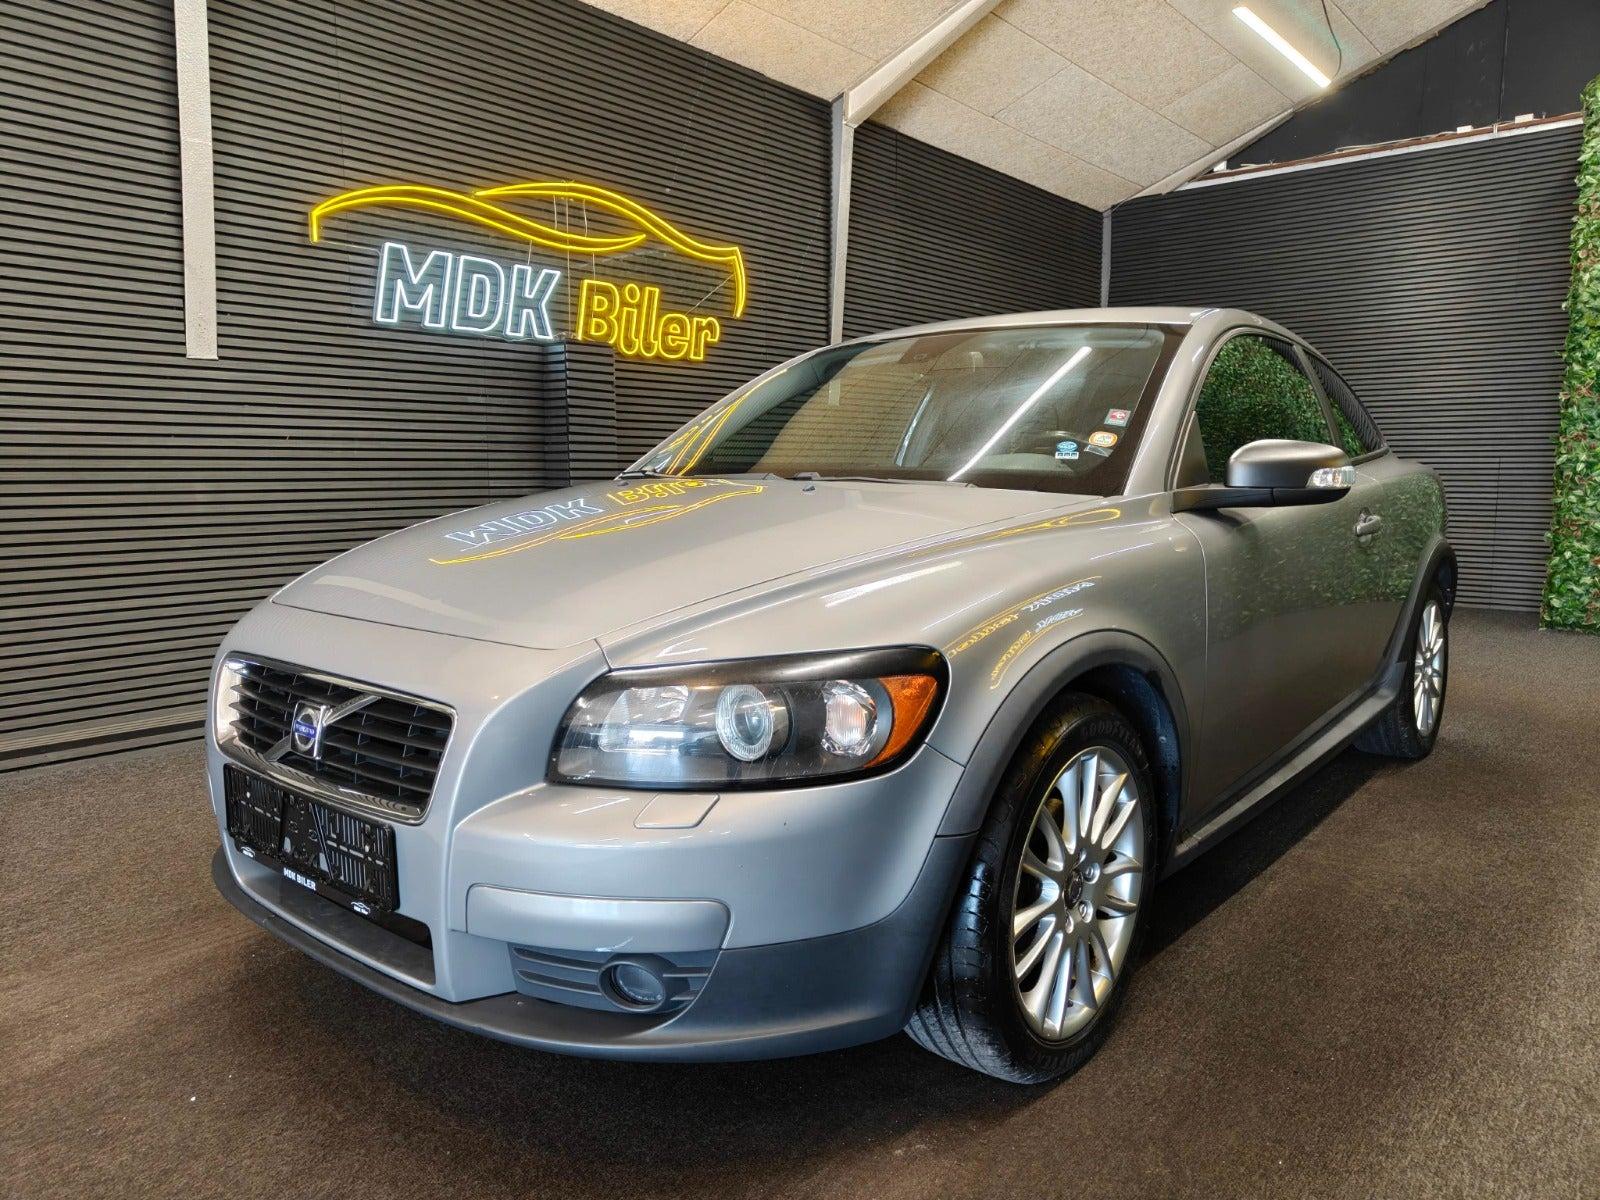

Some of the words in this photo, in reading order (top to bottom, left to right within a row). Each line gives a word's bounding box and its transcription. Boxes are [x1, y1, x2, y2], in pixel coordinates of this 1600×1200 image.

[373, 241, 561, 340] MDK
[576, 279, 720, 361] Biler
[283, 867, 296, 881] MDK
[296, 873, 317, 892] BILER
